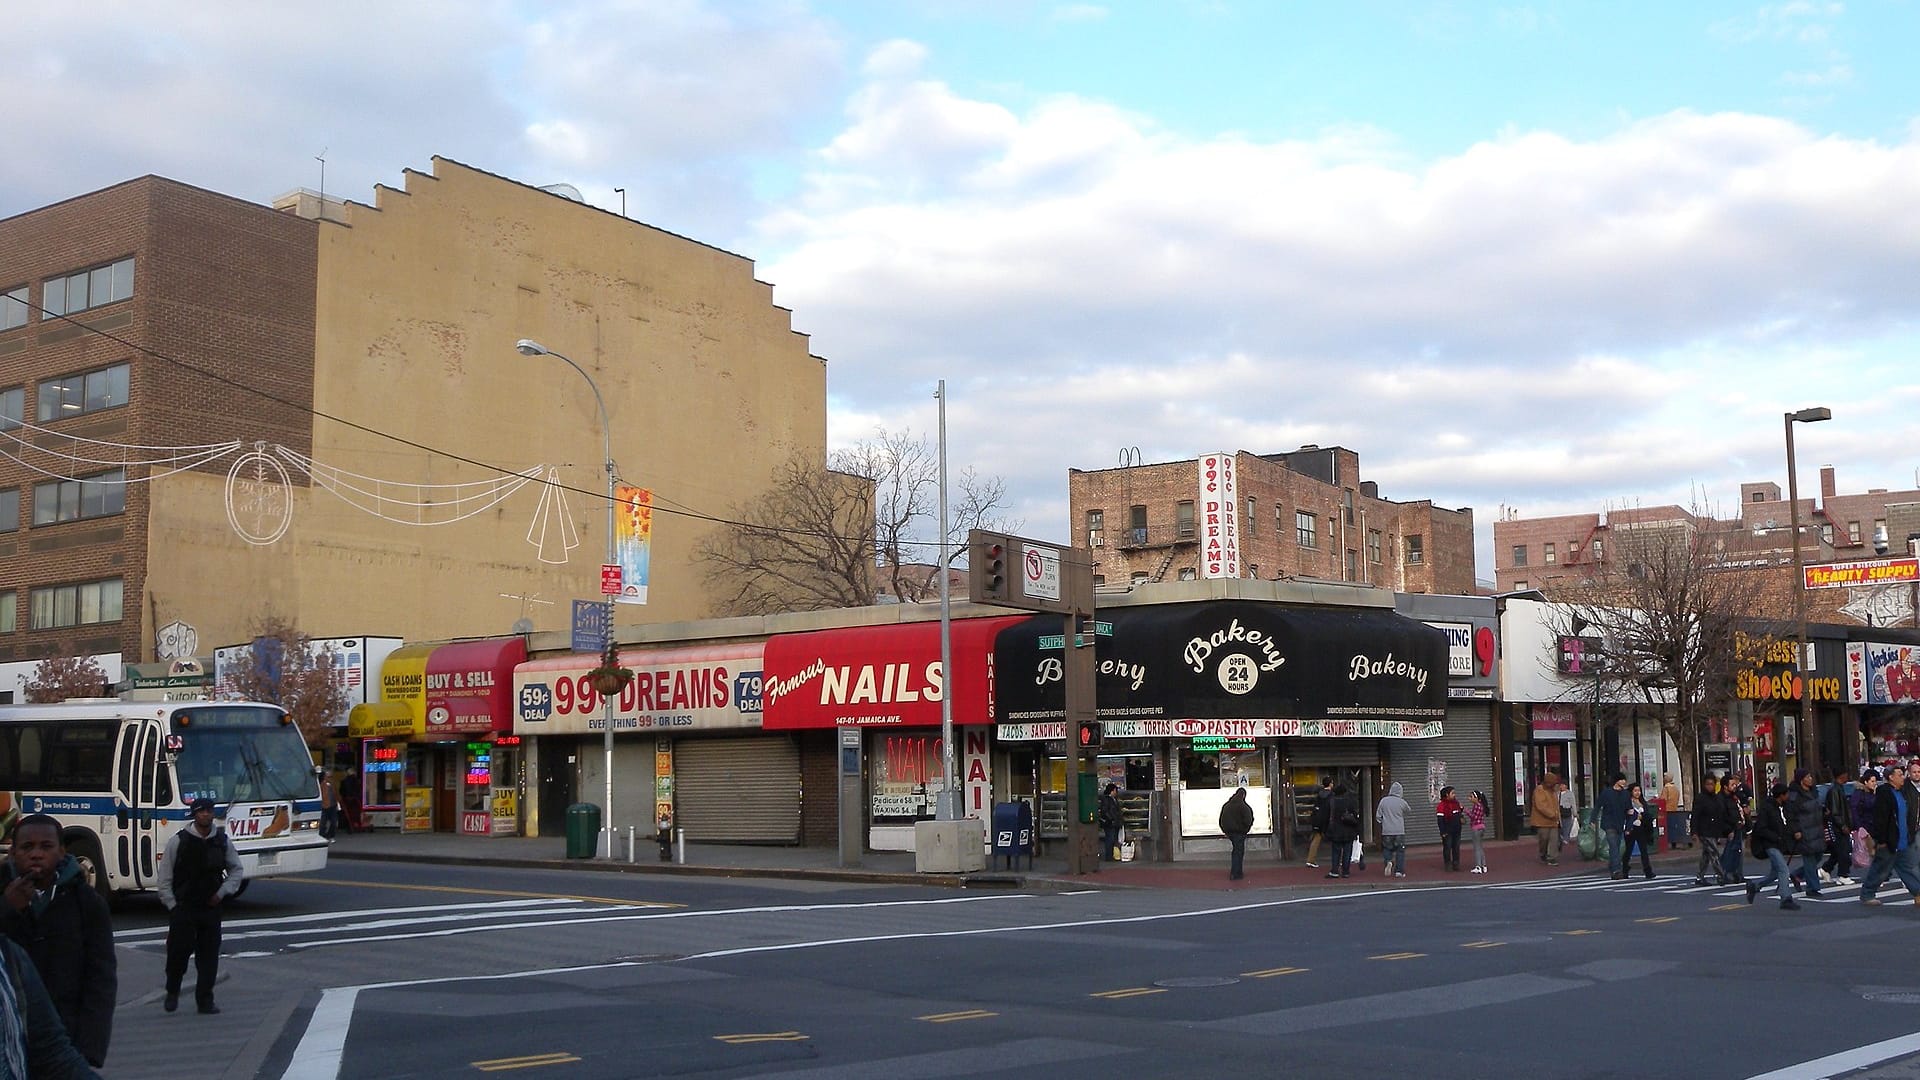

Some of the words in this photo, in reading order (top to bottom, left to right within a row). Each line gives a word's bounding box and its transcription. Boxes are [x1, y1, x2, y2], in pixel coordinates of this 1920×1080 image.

[1205, 457, 1217, 493] 99¢
[1224, 458, 1233, 493] 99¢
[1206, 501, 1222, 574] DREAMS
[1225, 501, 1236, 574] DREAMS
[1813, 568, 1864, 583] BEAUTY
[1868, 565, 1917, 579] SUPPLY
[1039, 636, 1066, 648] SUTPH
[1184, 618, 1286, 674] Bakery
[1229, 657, 1246, 666] OPEN
[383, 675, 400, 686] CASH
[401, 674, 423, 686] LOANS
[426, 673, 451, 689] BUY
[454, 673, 465, 688] &
[467, 671, 495, 687] SELL
[1035, 657, 1145, 691] Bery
[1228, 667, 1249, 682] 24
[1349, 652, 1428, 693] Bakery
[739, 677, 763, 697] 79
[764, 656, 826, 706] Famous
[820, 661, 944, 706] NAILS
[987, 652, 995, 719] NAILS
[1227, 683, 1249, 691] HOURS
[522, 687, 549, 706] 59¢
[555, 675, 606, 715] 99
[619, 667, 729, 712] DREAMS
[455, 715, 469, 723] BUY
[477, 715, 492, 723] SELL
[524, 709, 546, 720] DEAL
[588, 717, 637, 729] EVERTHING
[658, 716, 670, 726] OR
[672, 715, 693, 726] LESS
[835, 716, 855, 725] 147-01
[856, 716, 886, 724] JAMAICA
[886, 715, 902, 723] AVE.
[1002, 725, 1024, 739] TACOS
[1031, 723, 1067, 738] SANDWICH
[1112, 721, 1136, 736] JUICES
[1143, 720, 1171, 735] TORTAS
[1207, 720, 1257, 735] PASTRY
[1264, 720, 1299, 736] SHOP
[1303, 721, 1320, 736] TACOS
[886, 736, 944, 784] NAILS
[1240, 774, 1248, 783] A
[495, 789, 515, 800] BUY
[873, 796, 904, 804] Pedicure
[494, 807, 516, 817] SELL
[874, 806, 900, 814] WAXING
[229, 818, 261, 836] V.I.M.
